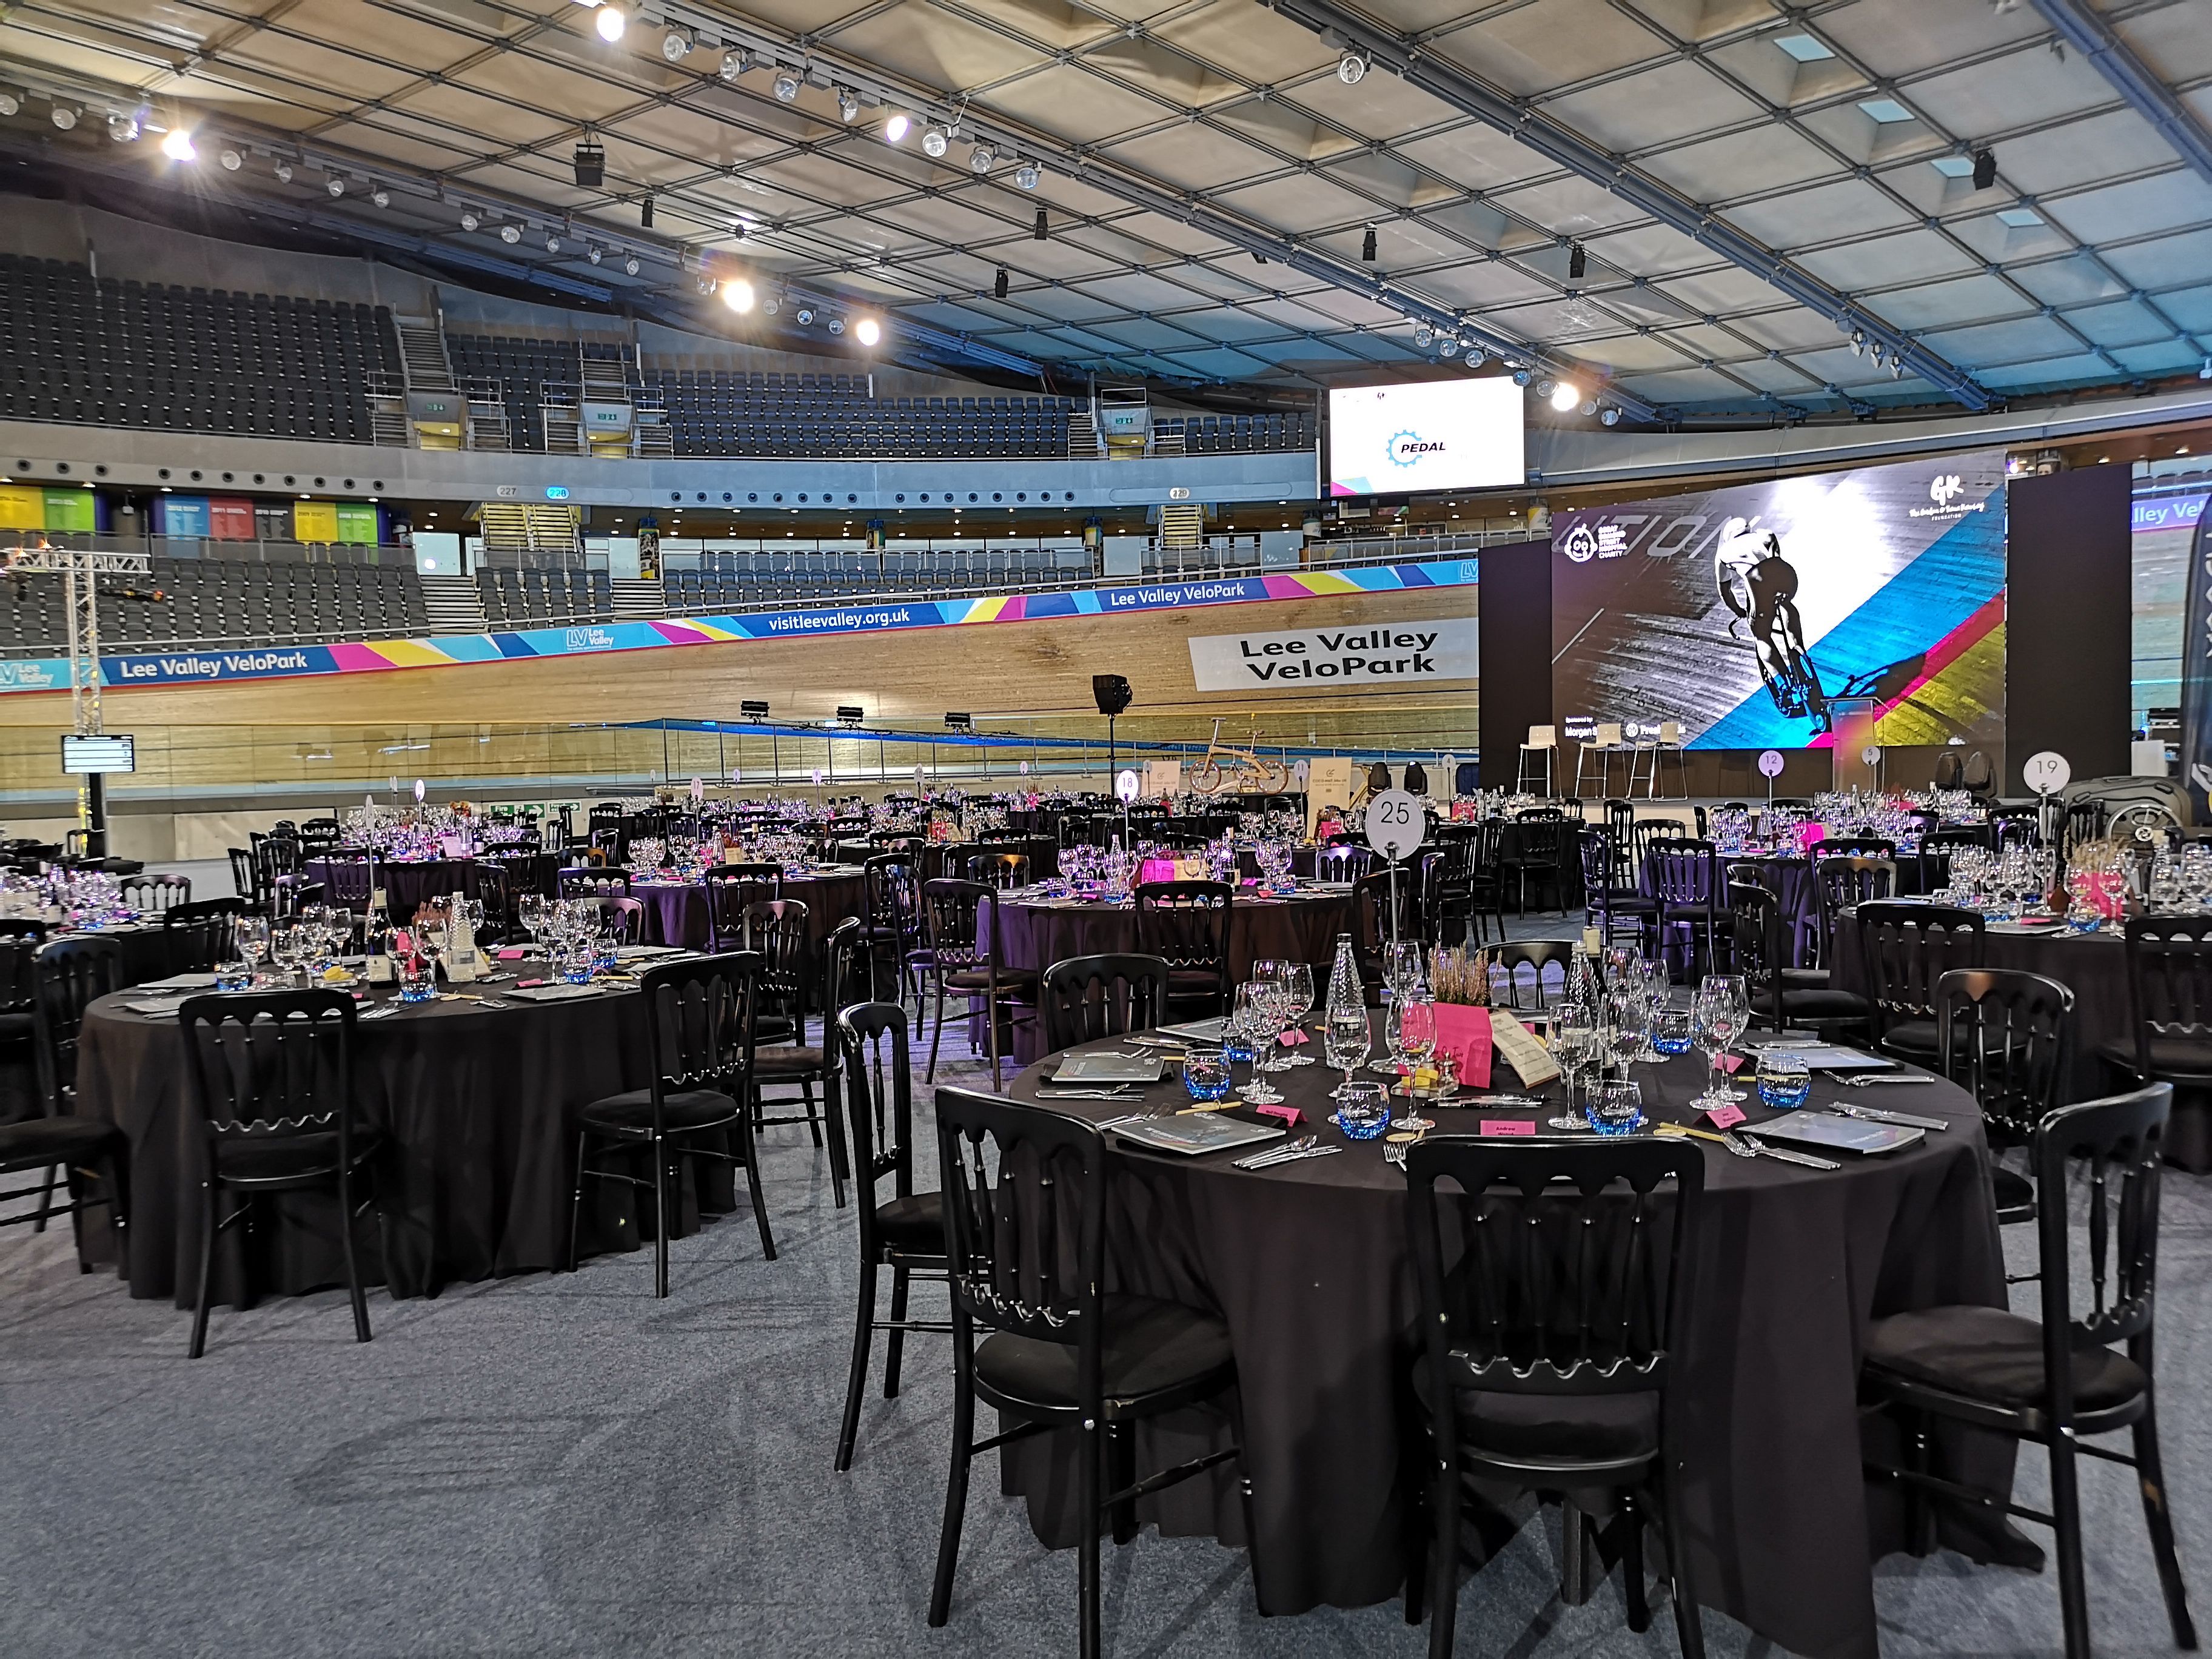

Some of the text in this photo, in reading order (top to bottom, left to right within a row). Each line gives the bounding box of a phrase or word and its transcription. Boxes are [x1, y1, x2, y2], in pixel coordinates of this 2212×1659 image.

[1401, 442, 1446, 454] PEDAL
[2132, 507, 2169, 525] lley
[1111, 583, 1245, 606] Lee Valley VeloPark
[768, 608, 910, 631] visitleevalley.org.uk
[566, 628, 588, 647] LV
[588, 637, 614, 646] Valley
[1240, 629, 1439, 657] Lee Valley
[121, 652, 308, 678] Lee Valley VeloPark
[1246, 653, 1436, 680] VeloPark
[1565, 726, 1592, 739] Morgan
[1766, 756, 1777, 764] 12
[2037, 760, 2058, 774] 19
[693, 780, 700, 789] 17
[1122, 777, 1133, 788] 18
[1381, 801, 1409, 825] 25
